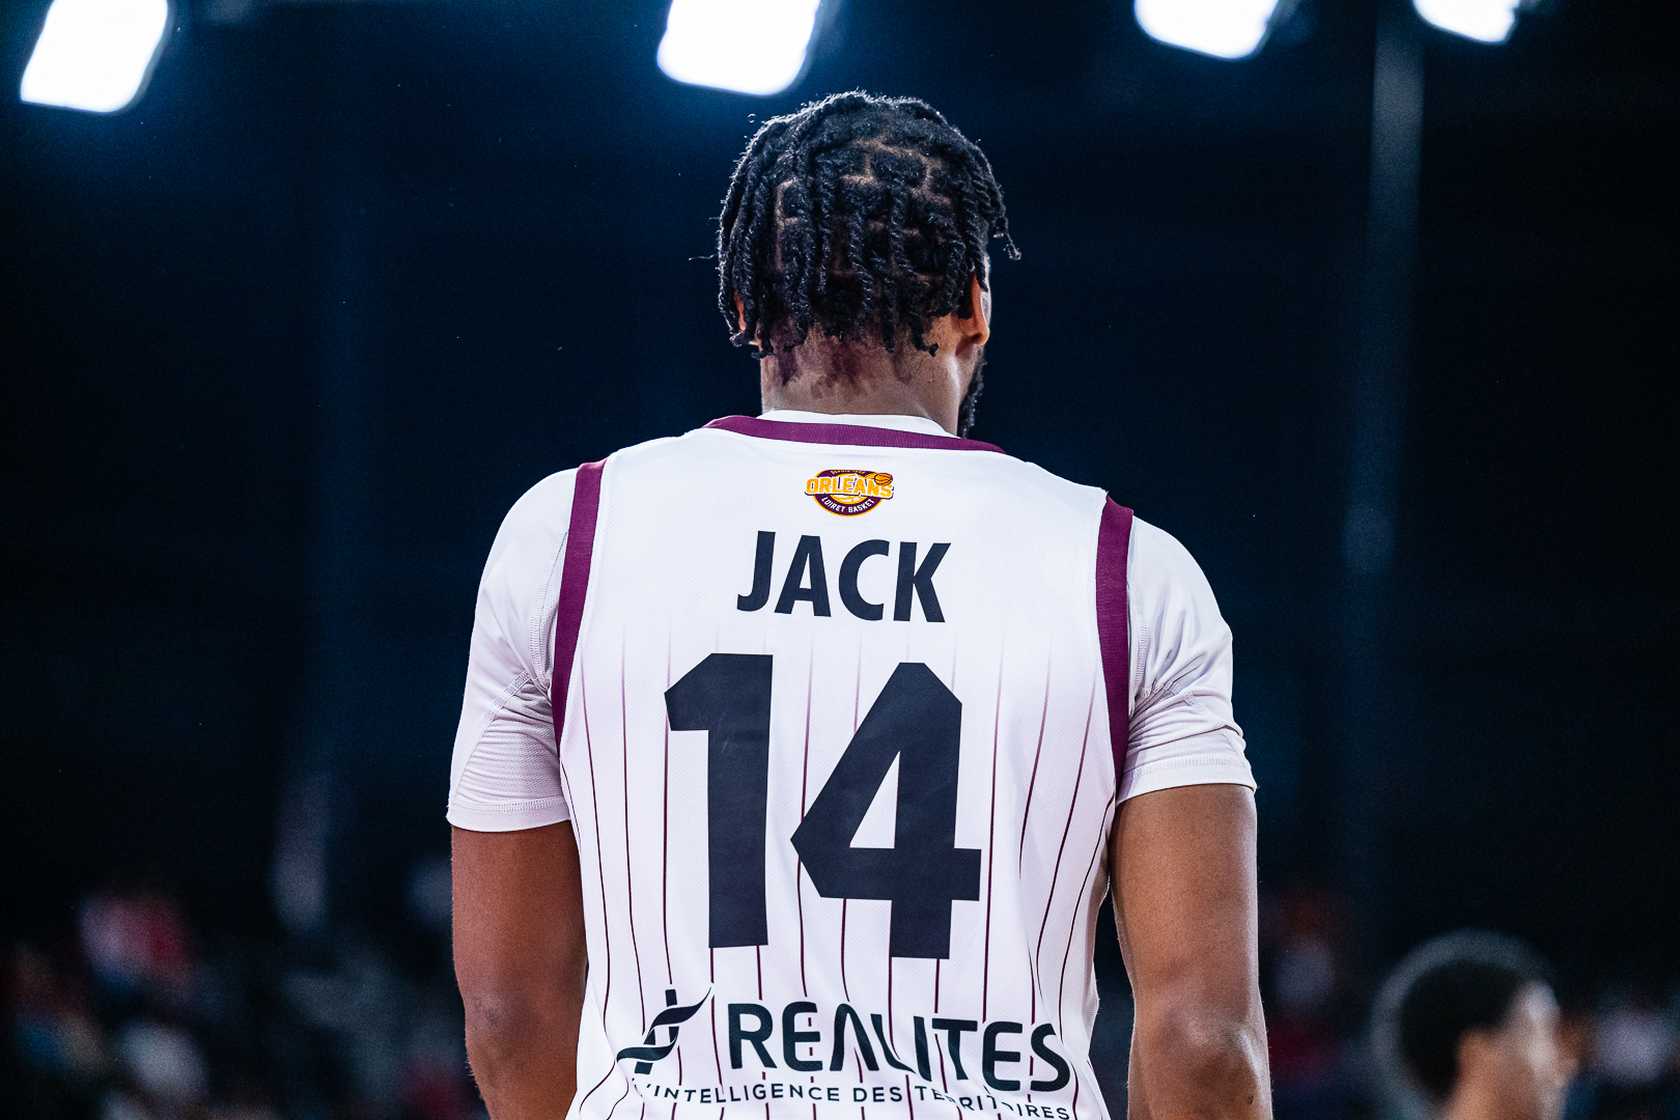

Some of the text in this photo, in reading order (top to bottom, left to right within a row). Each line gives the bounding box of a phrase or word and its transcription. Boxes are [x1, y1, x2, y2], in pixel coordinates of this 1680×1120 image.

[821, 497, 874, 513] LOIRET BASKET
[737, 531, 951, 622] JACK
[665, 652, 981, 960] 14
[853, 1086, 902, 1103] DES
